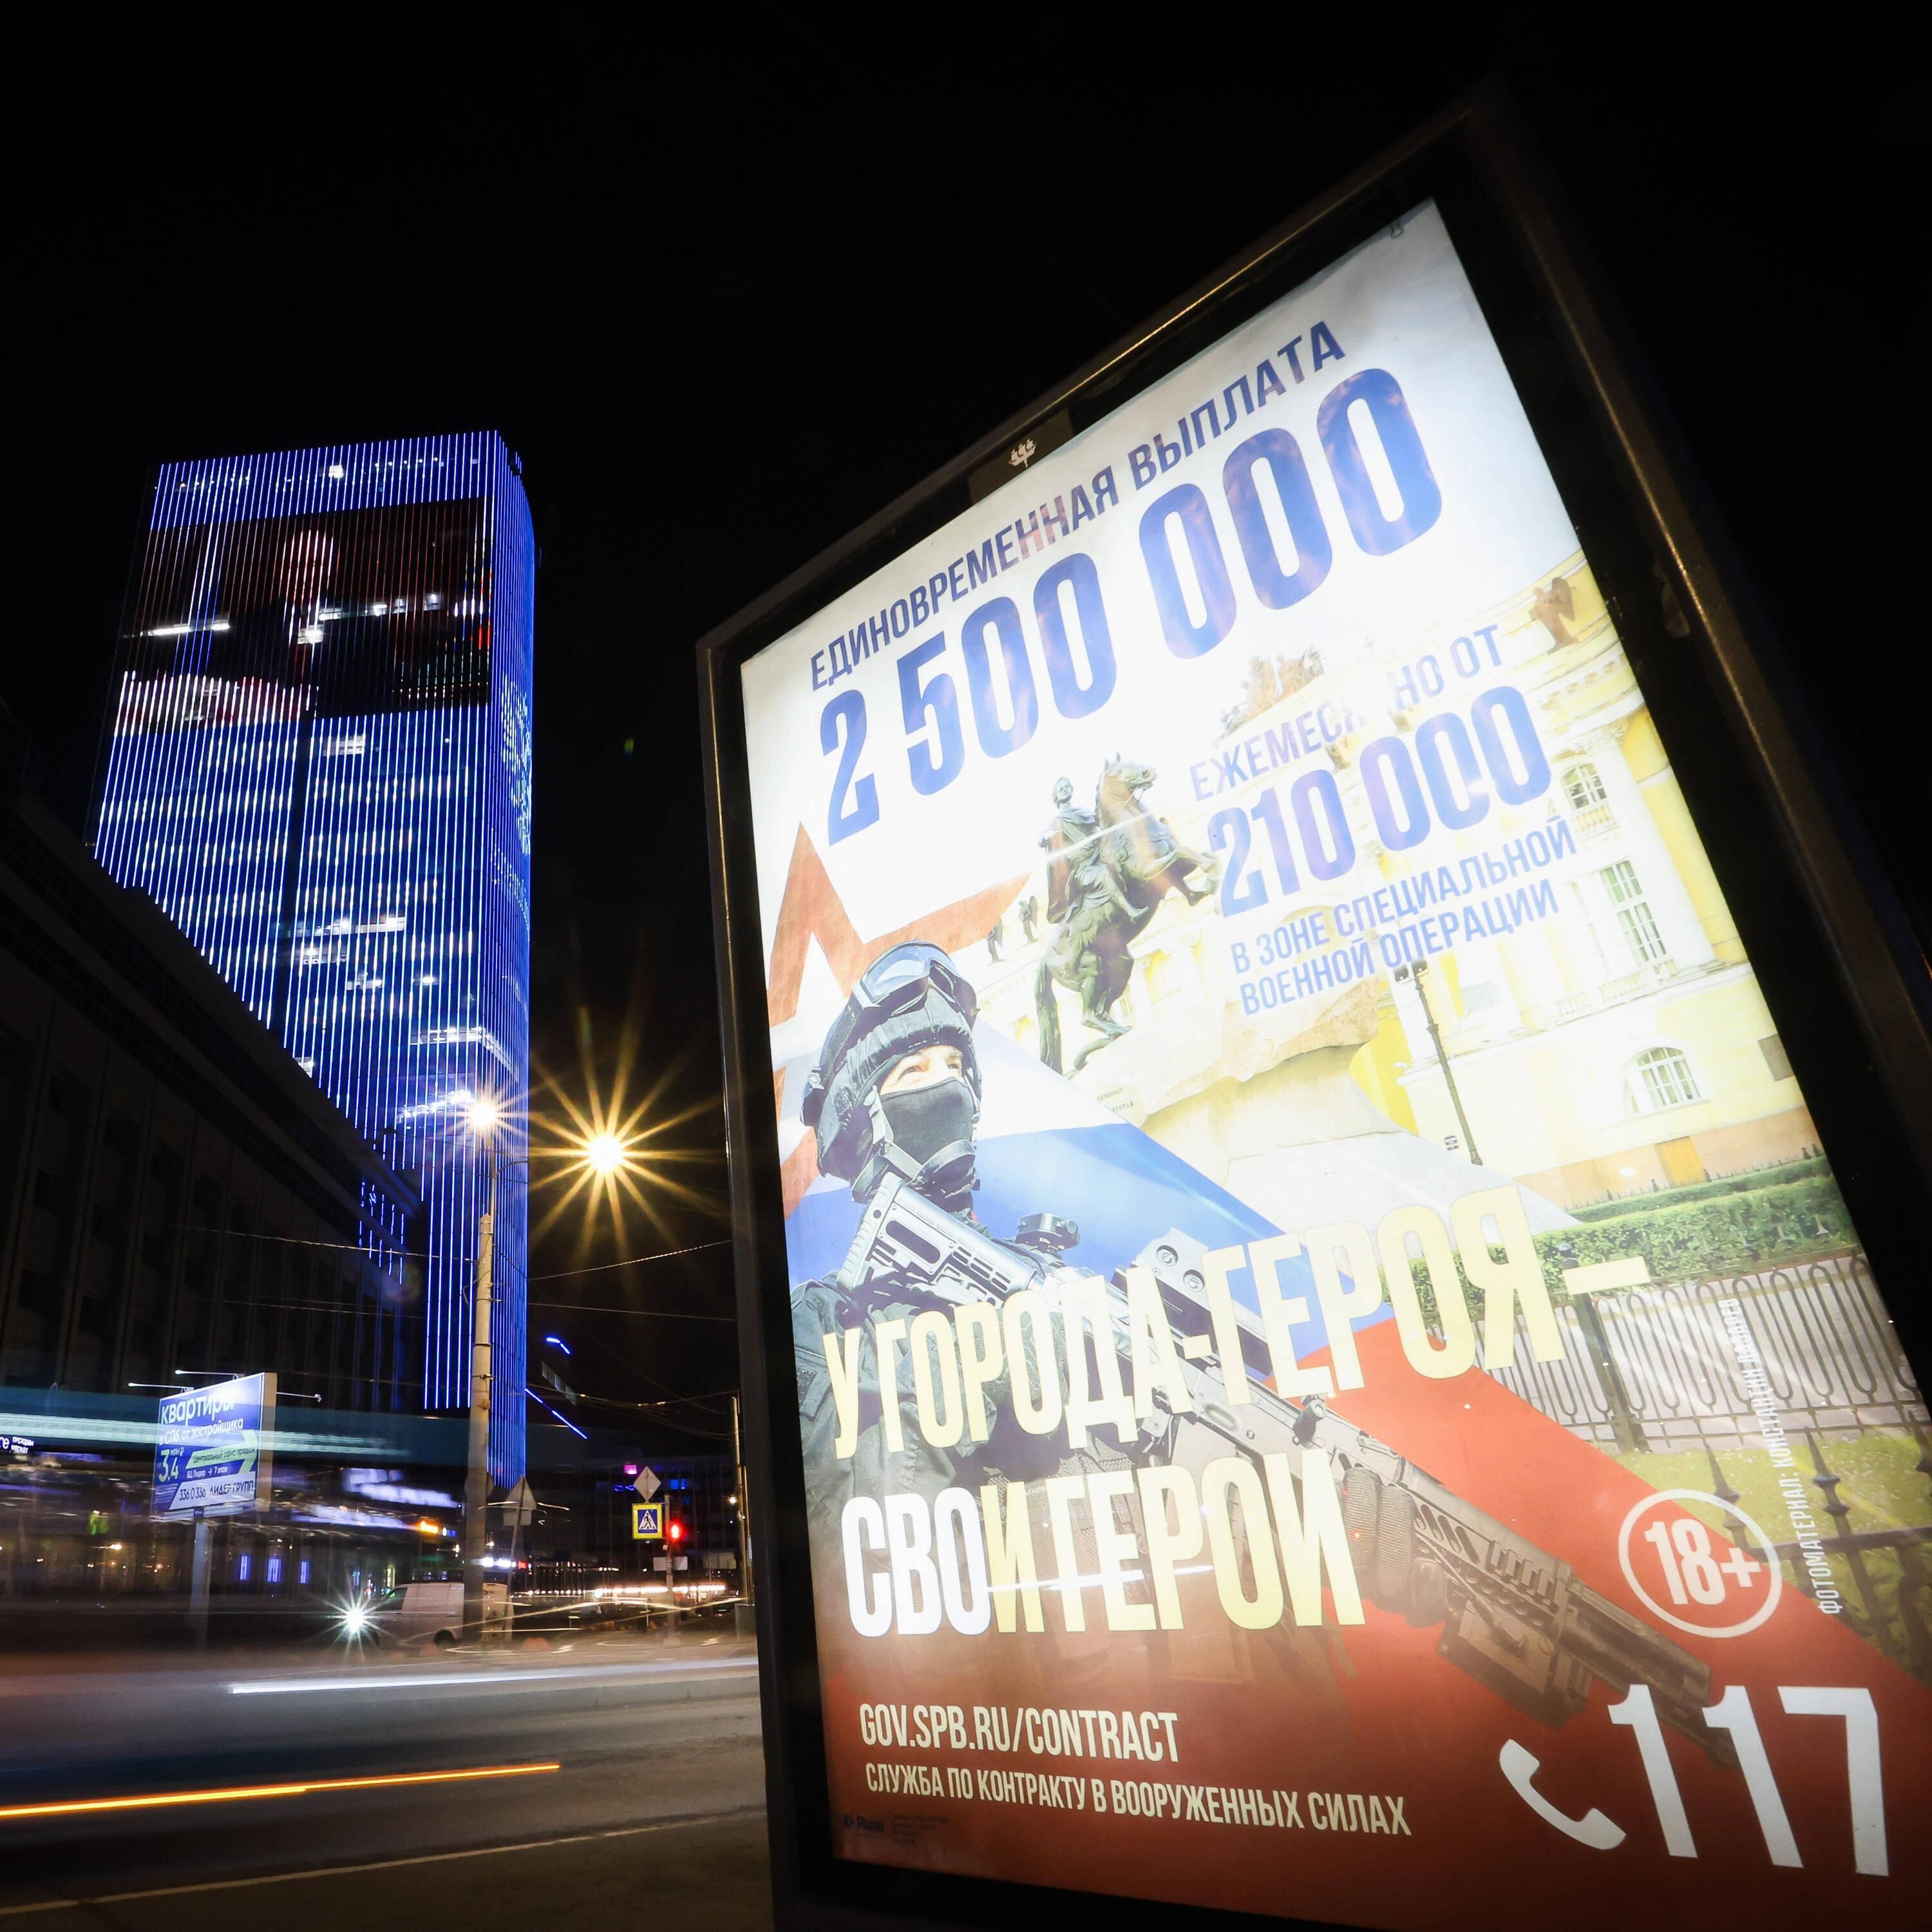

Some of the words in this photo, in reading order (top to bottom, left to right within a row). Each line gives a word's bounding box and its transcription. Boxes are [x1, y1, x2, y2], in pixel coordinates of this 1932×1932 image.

[811, 466, 1119, 692] ЕДИНОВРЕМЕННАЯ
[1127, 321, 1345, 491] ВЫПЛАТА
[820, 688, 880, 846] 2
[897, 552, 1117, 795] 500
[1139, 368, 1442, 659] 000
[1450, 624, 1501, 679] ОТ
[1208, 769, 1355, 918] 210
[1359, 685, 1551, 851] 000
[1231, 942, 1251, 974] В
[1256, 913, 1330, 965] ЗОНЕ
[1334, 815, 1577, 938] СПЕЦИАЛЬНОЙ
[1240, 937, 1375, 1016] ВОЕННОЙ
[1379, 878, 1559, 968] ОПЕРАЦИИ
[822, 1327, 861, 1461] У
[876, 1185, 1567, 1449] ГОРОДА-ГЕРОЯ
[1741, 1368, 1795, 1468] КОНСТАНТИН
[841, 1484, 1045, 1638] СВОИ
[1044, 1449, 1366, 1632] ГЕРОИ
[1643, 1519, 1760, 1605] 18+
[1779, 1472, 1843, 1615] ФОТОМАТЕРИАЛ:
[859, 1703, 1179, 1763] GOV.SPB.RU/CONTRACT
[866, 1762, 944, 1797] СЛУЖБА
[947, 1768, 974, 1800] ПО
[976, 1769, 1086, 1811] КОНТРАКТУ
[1092, 1778, 1107, 1812] В
[1110, 1780, 1305, 1830] ВООРУЖЕННЫХ
[1307, 1791, 1412, 1837] СИЛАХ
[1607, 1683, 1889, 1877] 117
